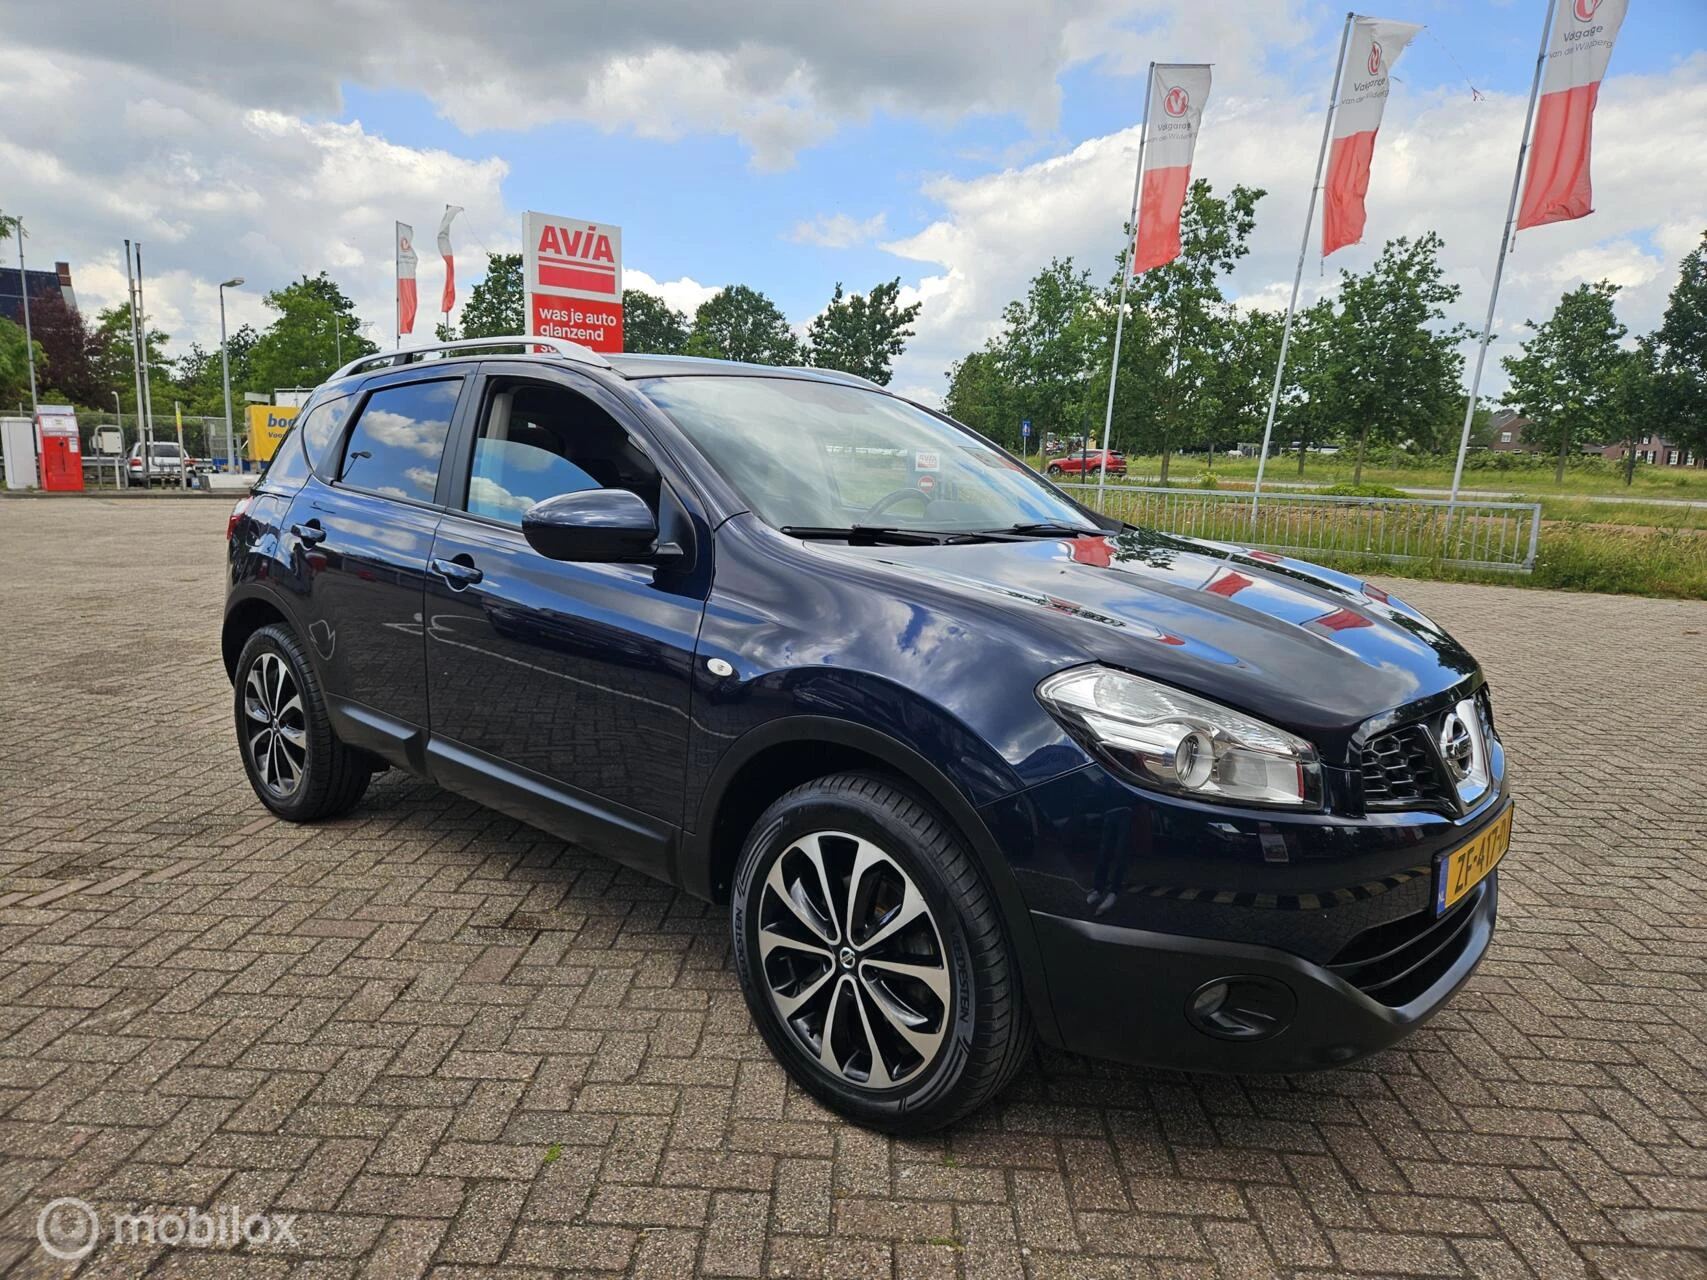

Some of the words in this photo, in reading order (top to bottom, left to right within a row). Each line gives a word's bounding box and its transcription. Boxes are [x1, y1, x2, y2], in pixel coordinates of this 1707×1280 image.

[538, 224, 615, 264] AVIA
[539, 308, 569, 321] was
[570, 308, 584, 326] je
[585, 311, 617, 327] auto
[540, 323, 604, 341] glanzend
